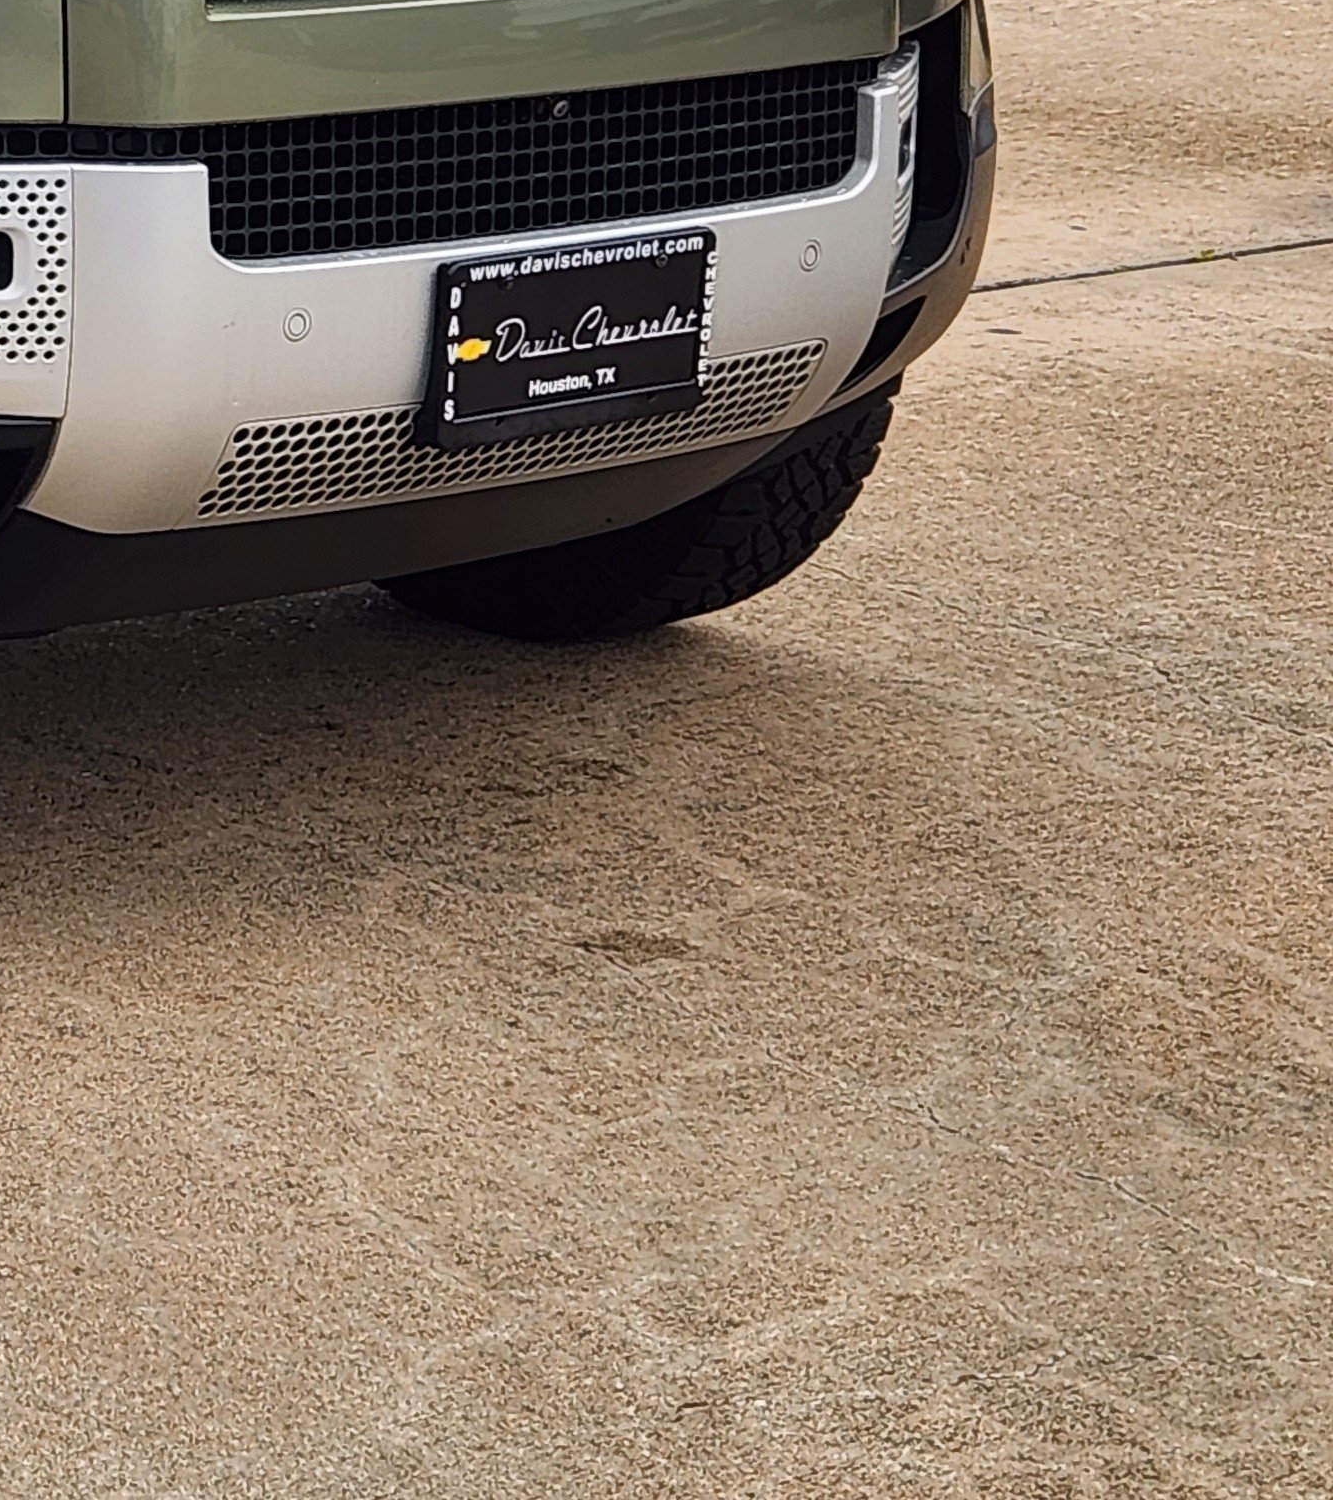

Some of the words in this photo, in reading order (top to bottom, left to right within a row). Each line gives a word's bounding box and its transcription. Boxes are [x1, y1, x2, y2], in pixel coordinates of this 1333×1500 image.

[469, 235, 704, 282] www.davischevrolet.com
[495, 318, 571, 362] Davis
[572, 305, 699, 350] Chevrolet
[697, 251, 719, 388] CHEVROLET
[443, 286, 462, 421] DAVIS
[528, 374, 593, 398] Houston,
[595, 366, 617, 384] TX
